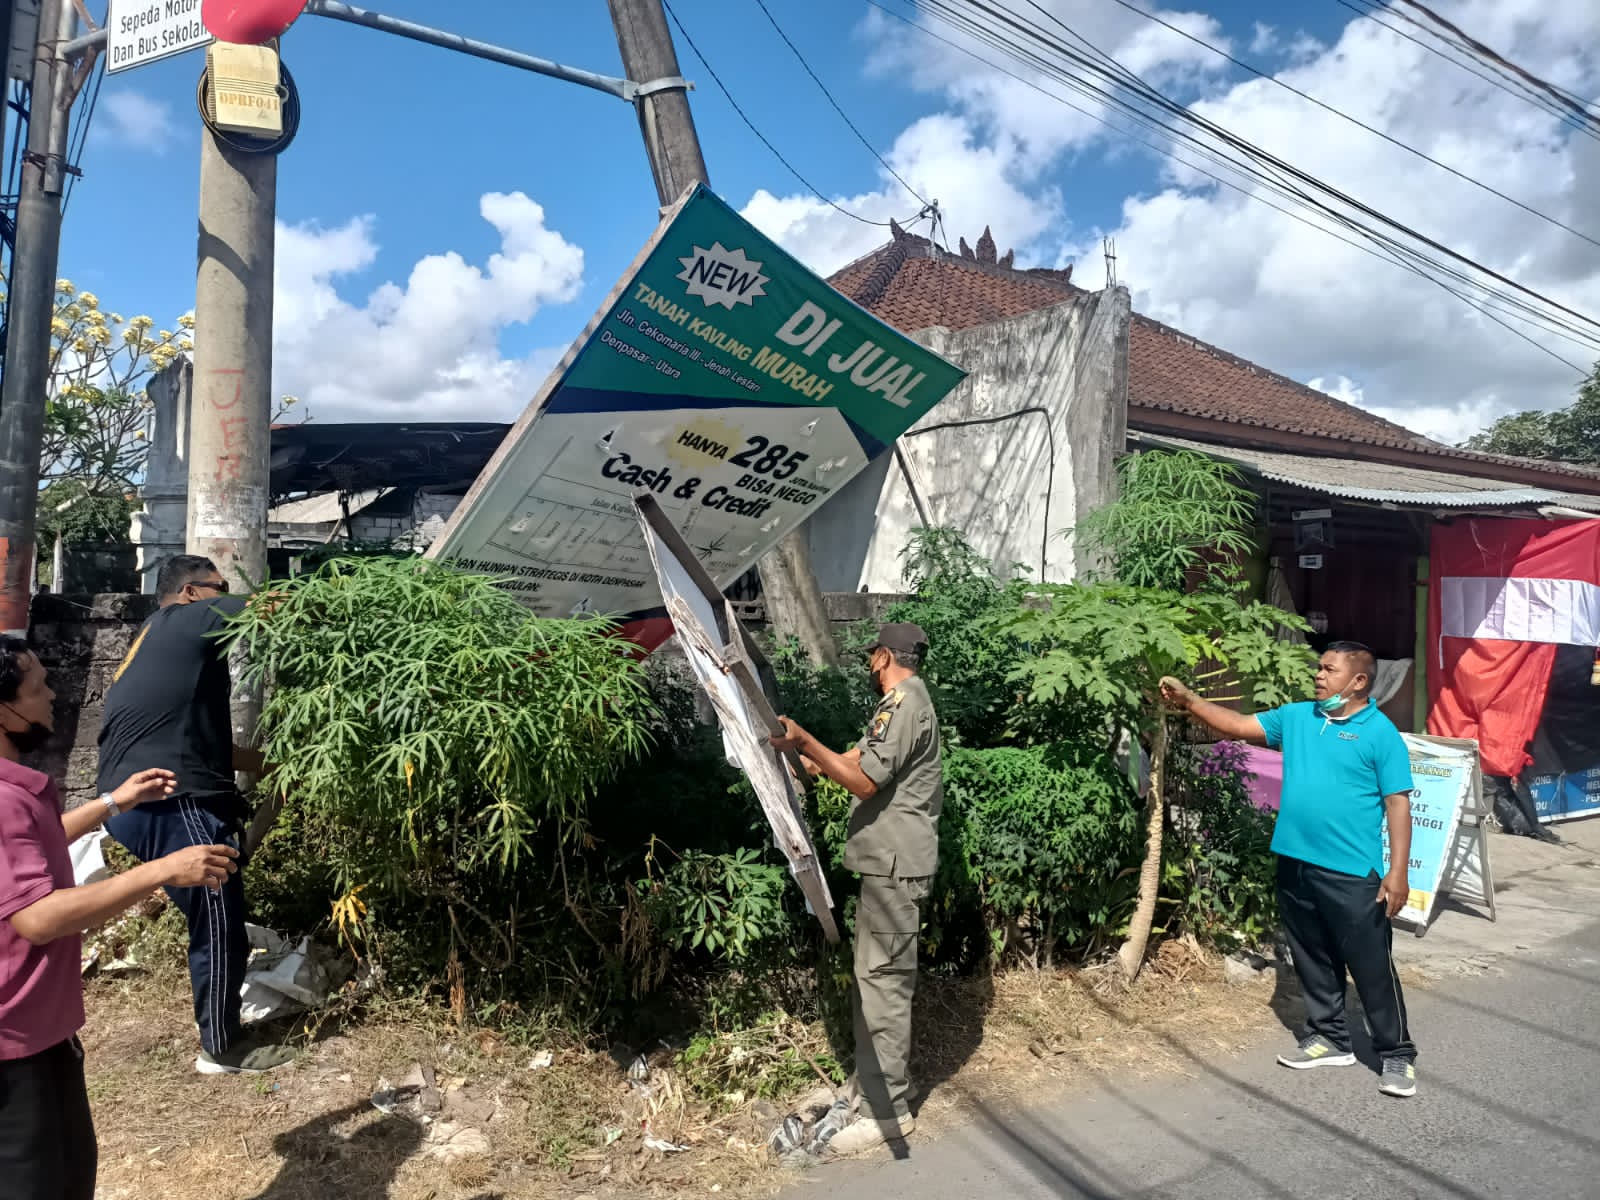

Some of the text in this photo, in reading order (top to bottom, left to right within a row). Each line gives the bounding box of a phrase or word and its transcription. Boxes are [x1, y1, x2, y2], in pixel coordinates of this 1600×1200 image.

[120, 0, 198, 34] Sepeda Motor
[113, 43, 134, 63] Dan
[138, 36, 158, 56] Bus
[687, 256, 759, 297] NEW
[600, 330, 650, 364] Denpasar
[655, 360, 682, 381] Utara
[616, 309, 635, 327] Jln.
[638, 320, 690, 356] Cekomaria
[704, 359, 732, 377] Jenah
[633, 283, 835, 401] TANAH KAVLING MURAH
[775, 300, 927, 409] DI JUAL
[676, 430, 729, 460] HANYA
[728, 435, 809, 480] 285
[601, 452, 774, 519] Cash & Credit
[735, 474, 817, 505] BISA NEGO
[476, 560, 518, 575] HUNIAN
